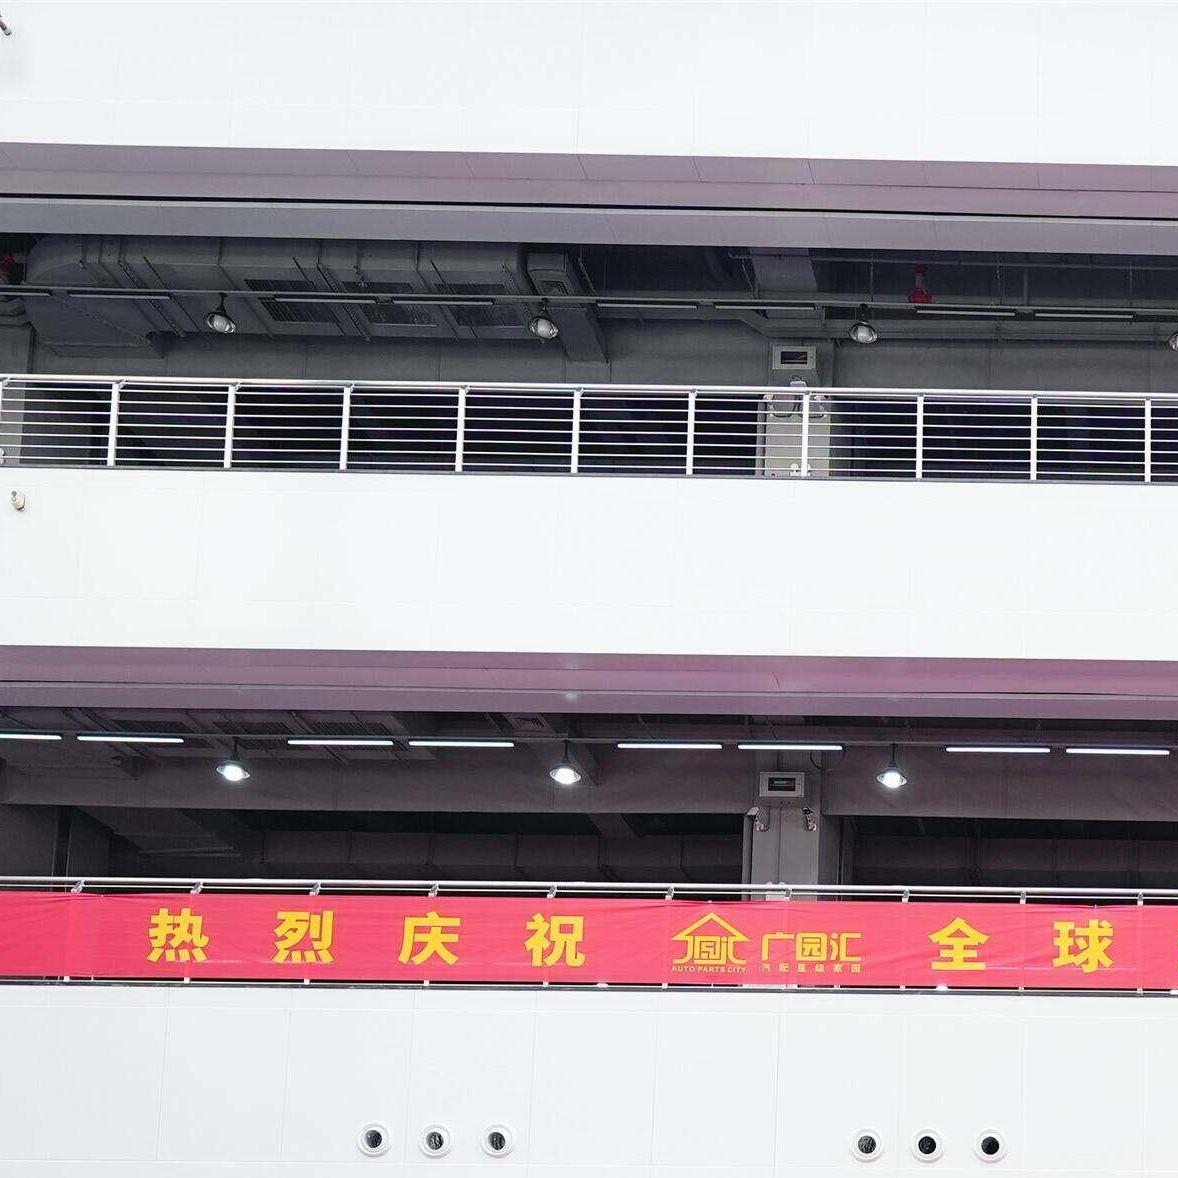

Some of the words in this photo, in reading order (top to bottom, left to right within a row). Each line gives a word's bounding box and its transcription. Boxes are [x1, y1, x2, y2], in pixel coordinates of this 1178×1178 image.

[147, 907, 586, 968] 热烈庆祝
[761, 932, 862, 962] 广园汇
